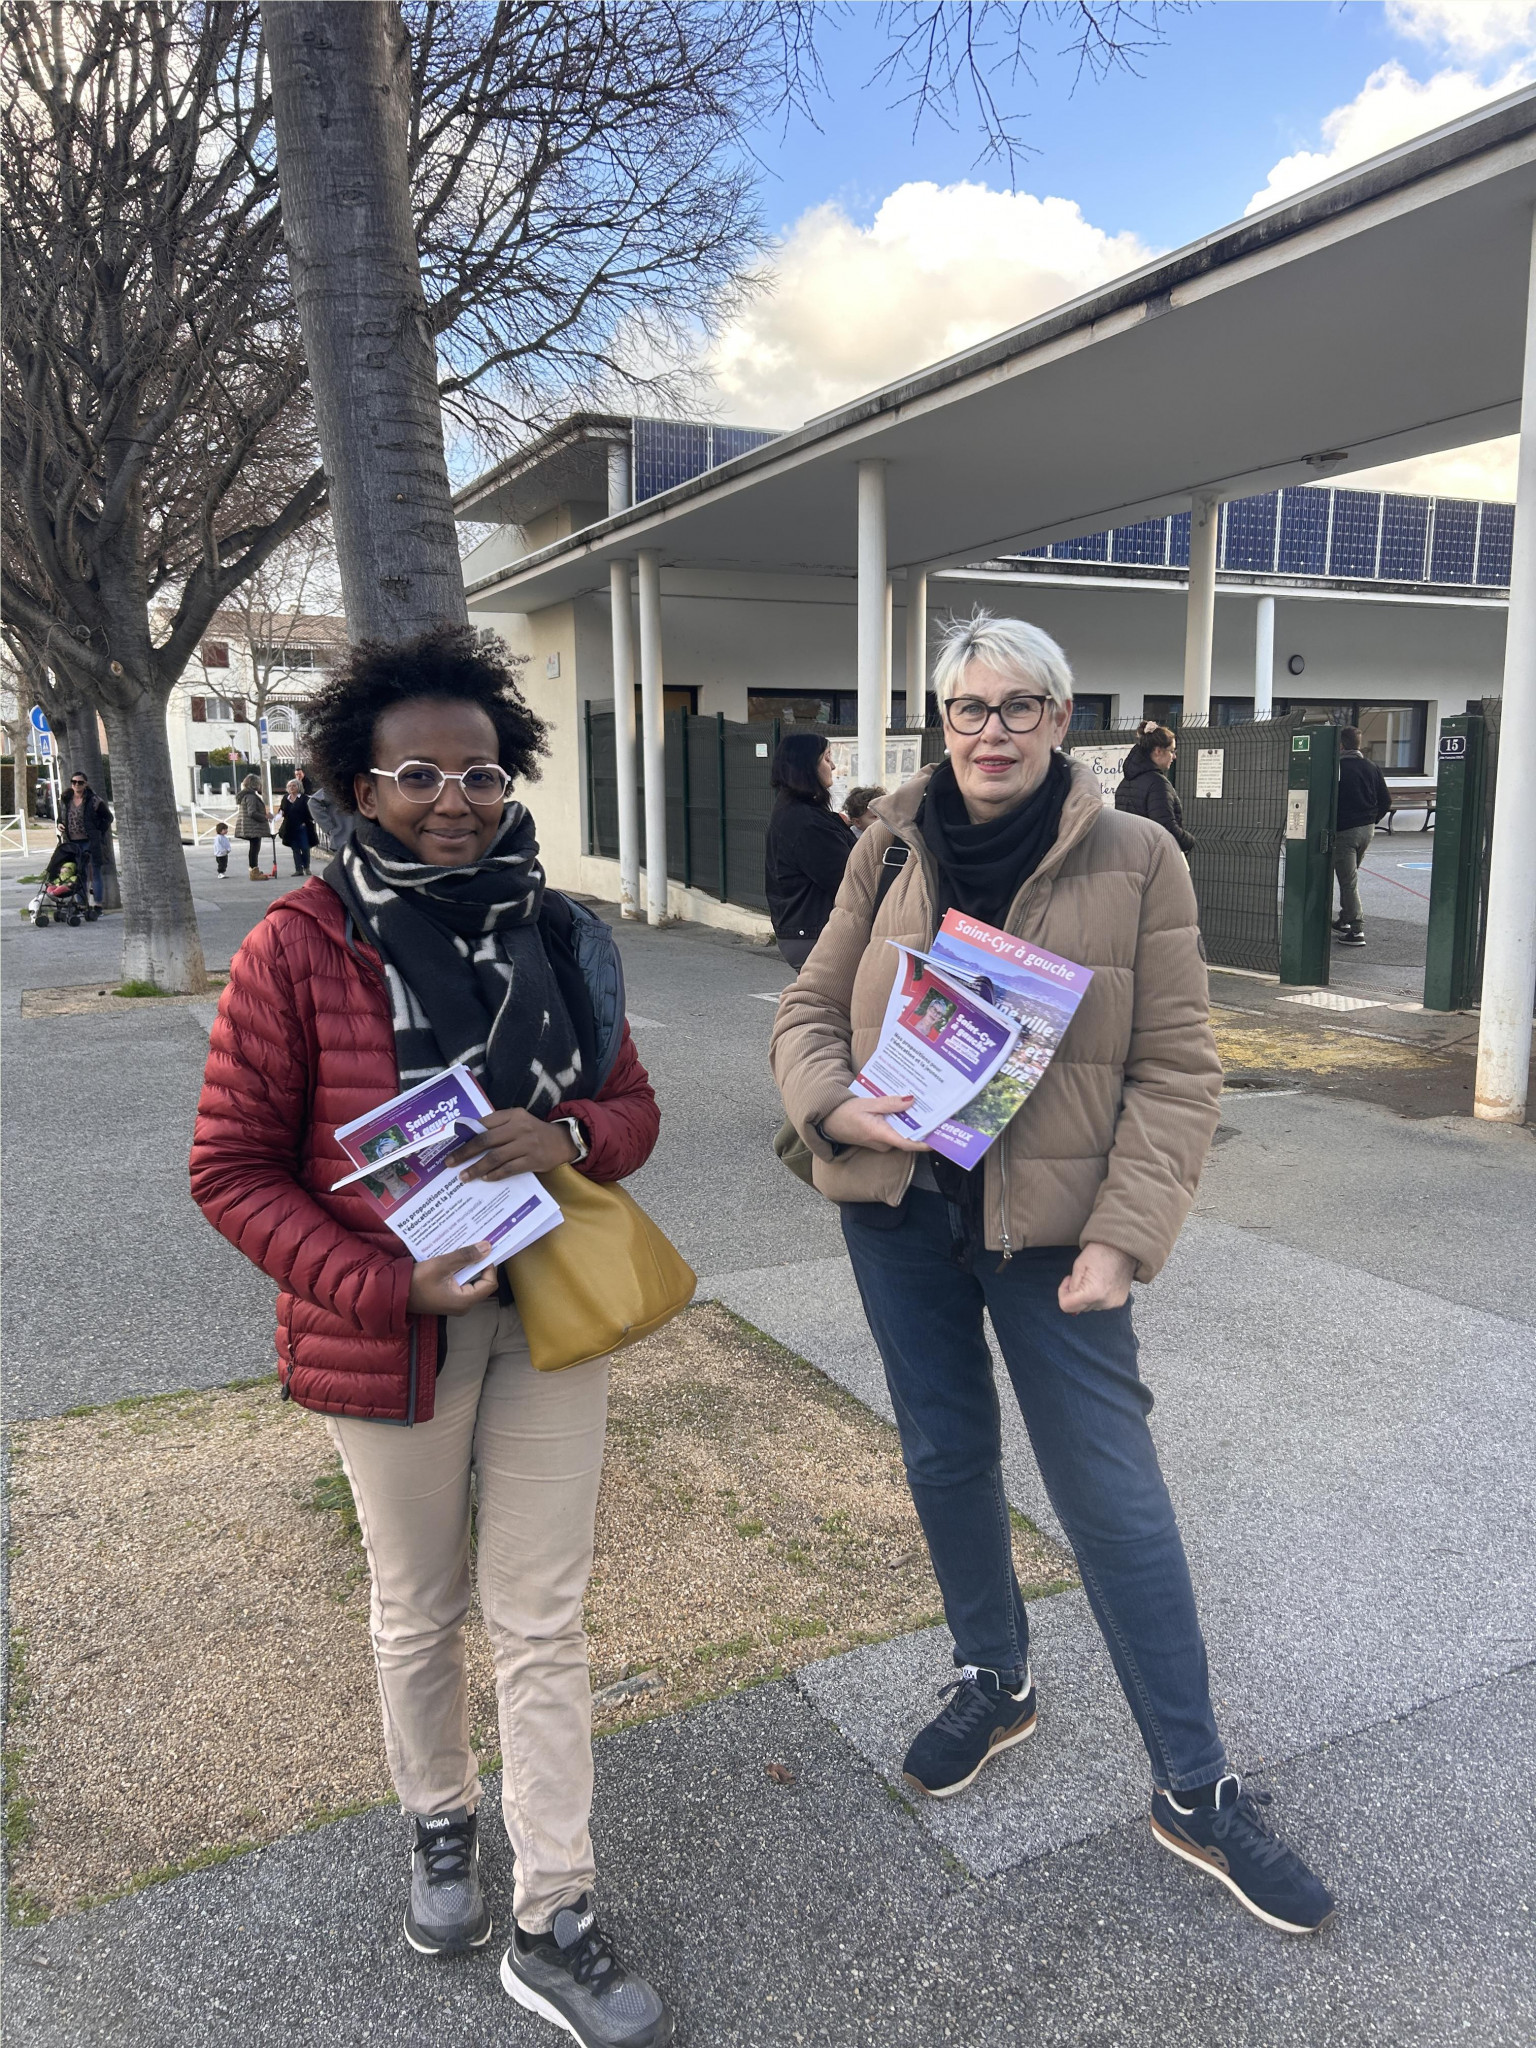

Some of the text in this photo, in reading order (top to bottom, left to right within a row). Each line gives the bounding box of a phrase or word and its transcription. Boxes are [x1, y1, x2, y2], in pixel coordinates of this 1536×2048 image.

[1446, 739, 1459, 751] 15
[1092, 757, 1124, 774] Ecol
[955, 920, 1076, 981] Saint-Cyr à gauche
[956, 1014, 996, 1047] Saint-Cyr
[1020, 1014, 1054, 1037] ville
[950, 1021, 959, 1031] à
[956, 1028, 987, 1053] gauche
[1025, 1046, 1042, 1060] et
[1000, 1063, 1030, 1082] aire
[405, 1095, 458, 1132] Saint-Cyr
[413, 1131, 421, 1141] à
[939, 1123, 974, 1141] eneux
[397, 1176, 458, 1229] Nos propositions pour
[402, 1206, 436, 1235] l'éducation
[435, 1200, 442, 1208] et
[446, 1182, 464, 1198] jeune
[426, 1817, 450, 1830] HOKA
